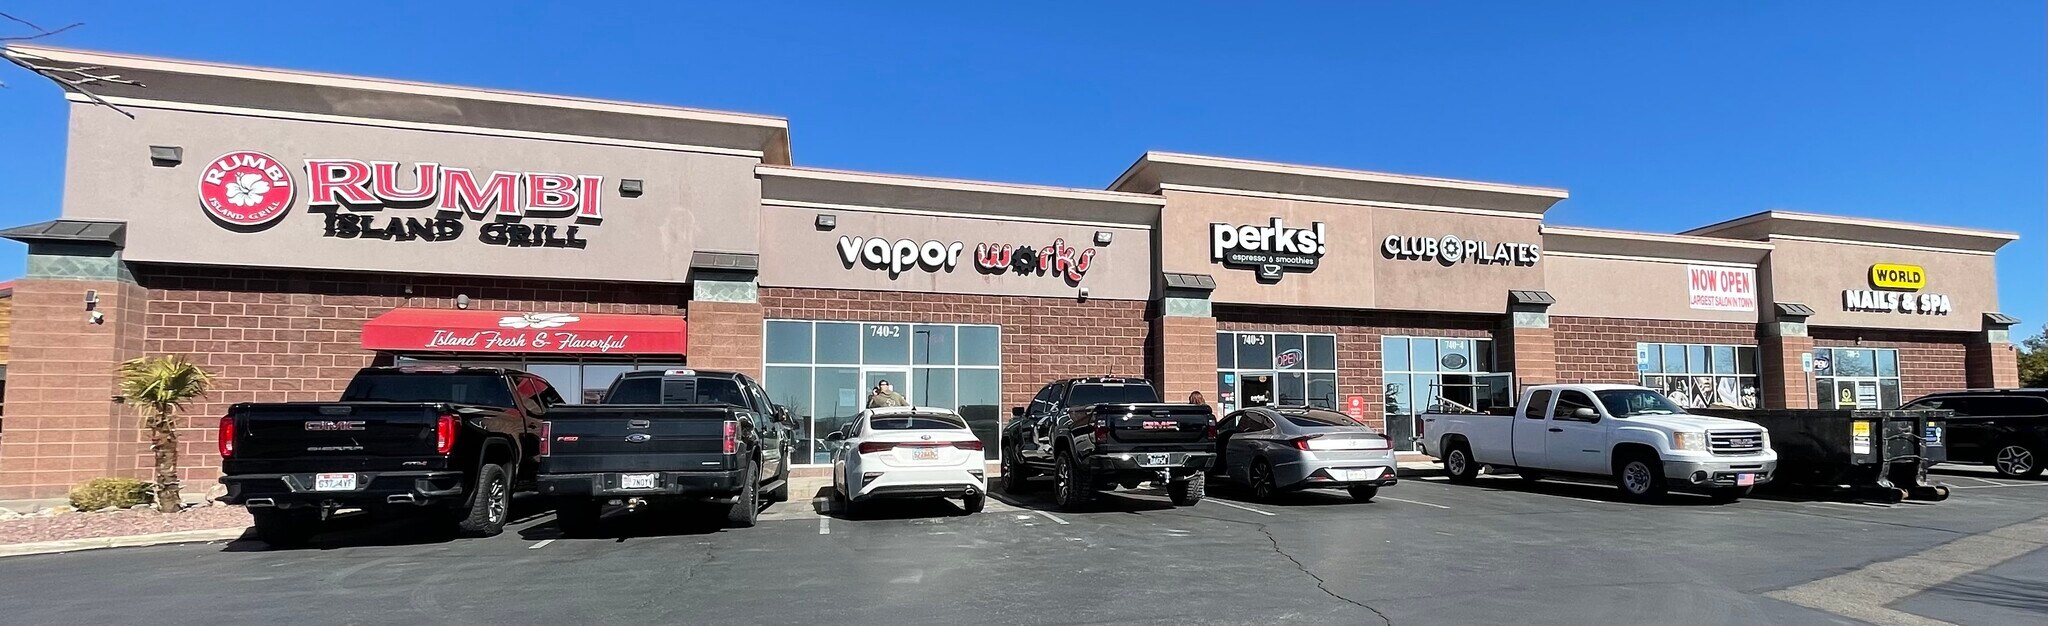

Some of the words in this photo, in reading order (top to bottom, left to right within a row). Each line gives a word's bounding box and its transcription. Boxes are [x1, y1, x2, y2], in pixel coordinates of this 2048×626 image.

[205, 155, 288, 186] RUMBI
[303, 158, 604, 221] RUMBI
[209, 197, 244, 220] ISLAND
[248, 201, 280, 219] GRILL
[323, 211, 464, 242] ISLAND
[479, 222, 587, 249] GRILL
[1214, 218, 1326, 258] perks!
[838, 235, 963, 277] vapor
[975, 238, 1095, 283] works
[1232, 253, 1266, 263] espresso
[1275, 255, 1314, 265] smoothies
[1384, 235, 1438, 257] CLUB
[1465, 240, 1541, 263] PILATES
[1691, 269, 1717, 291] NOW
[1720, 270, 1749, 293] OPEN
[1876, 269, 1921, 283] WORLD
[1691, 295, 1714, 306] LARGEST
[1715, 296, 1731, 307] SALON
[1738, 297, 1753, 308] TOWN
[1845, 290, 1898, 310] NAILS
[1902, 292, 1917, 312] &
[1920, 293, 1952, 312] SPA
[425, 330, 477, 348] Island
[479, 331, 526, 348] Fresh
[532, 331, 551, 348] &
[554, 332, 629, 352] Flavorful
[870, 325, 900, 337] 740-2
[1242, 334, 1265, 345] 740-3
[1445, 340, 1464, 349] 740-4
[1277, 352, 1300, 366] OPEN
[305, 421, 365, 430] GMC
